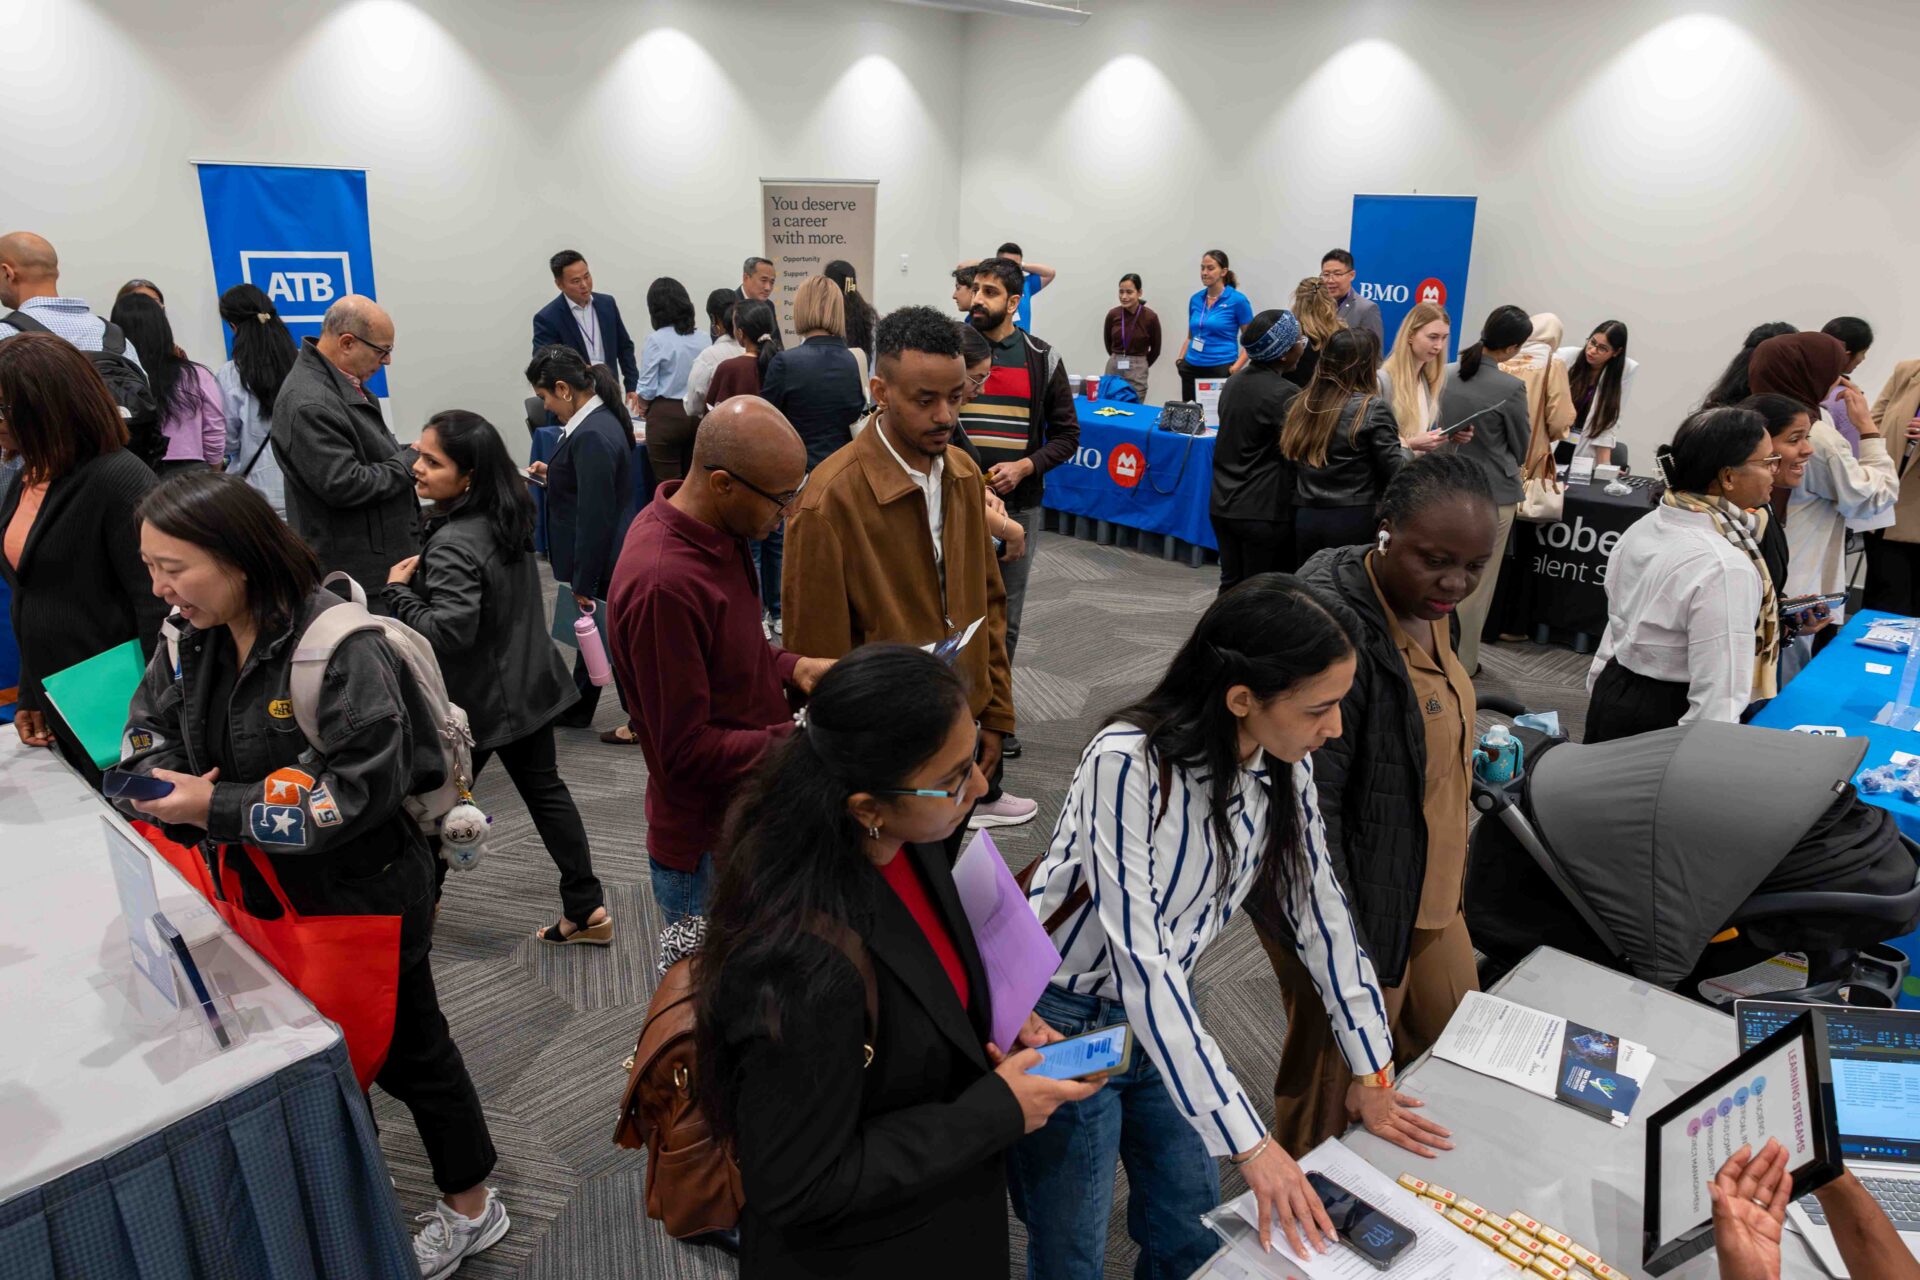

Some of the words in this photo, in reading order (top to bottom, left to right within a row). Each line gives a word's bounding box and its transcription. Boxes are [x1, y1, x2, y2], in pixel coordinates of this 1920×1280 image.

[771, 196, 798, 211] You
[801, 196, 856, 211] deserve
[772, 216, 781, 227] a
[784, 216, 828, 227] career
[772, 231, 805, 244] with
[808, 233, 847, 244] more.
[783, 256, 820, 264] Opportunity
[267, 272, 334, 302] ATB
[1360, 282, 1409, 303] BMO
[1787, 1048, 1801, 1101] LEARNING
[1792, 1101, 1805, 1154] STREAMS
